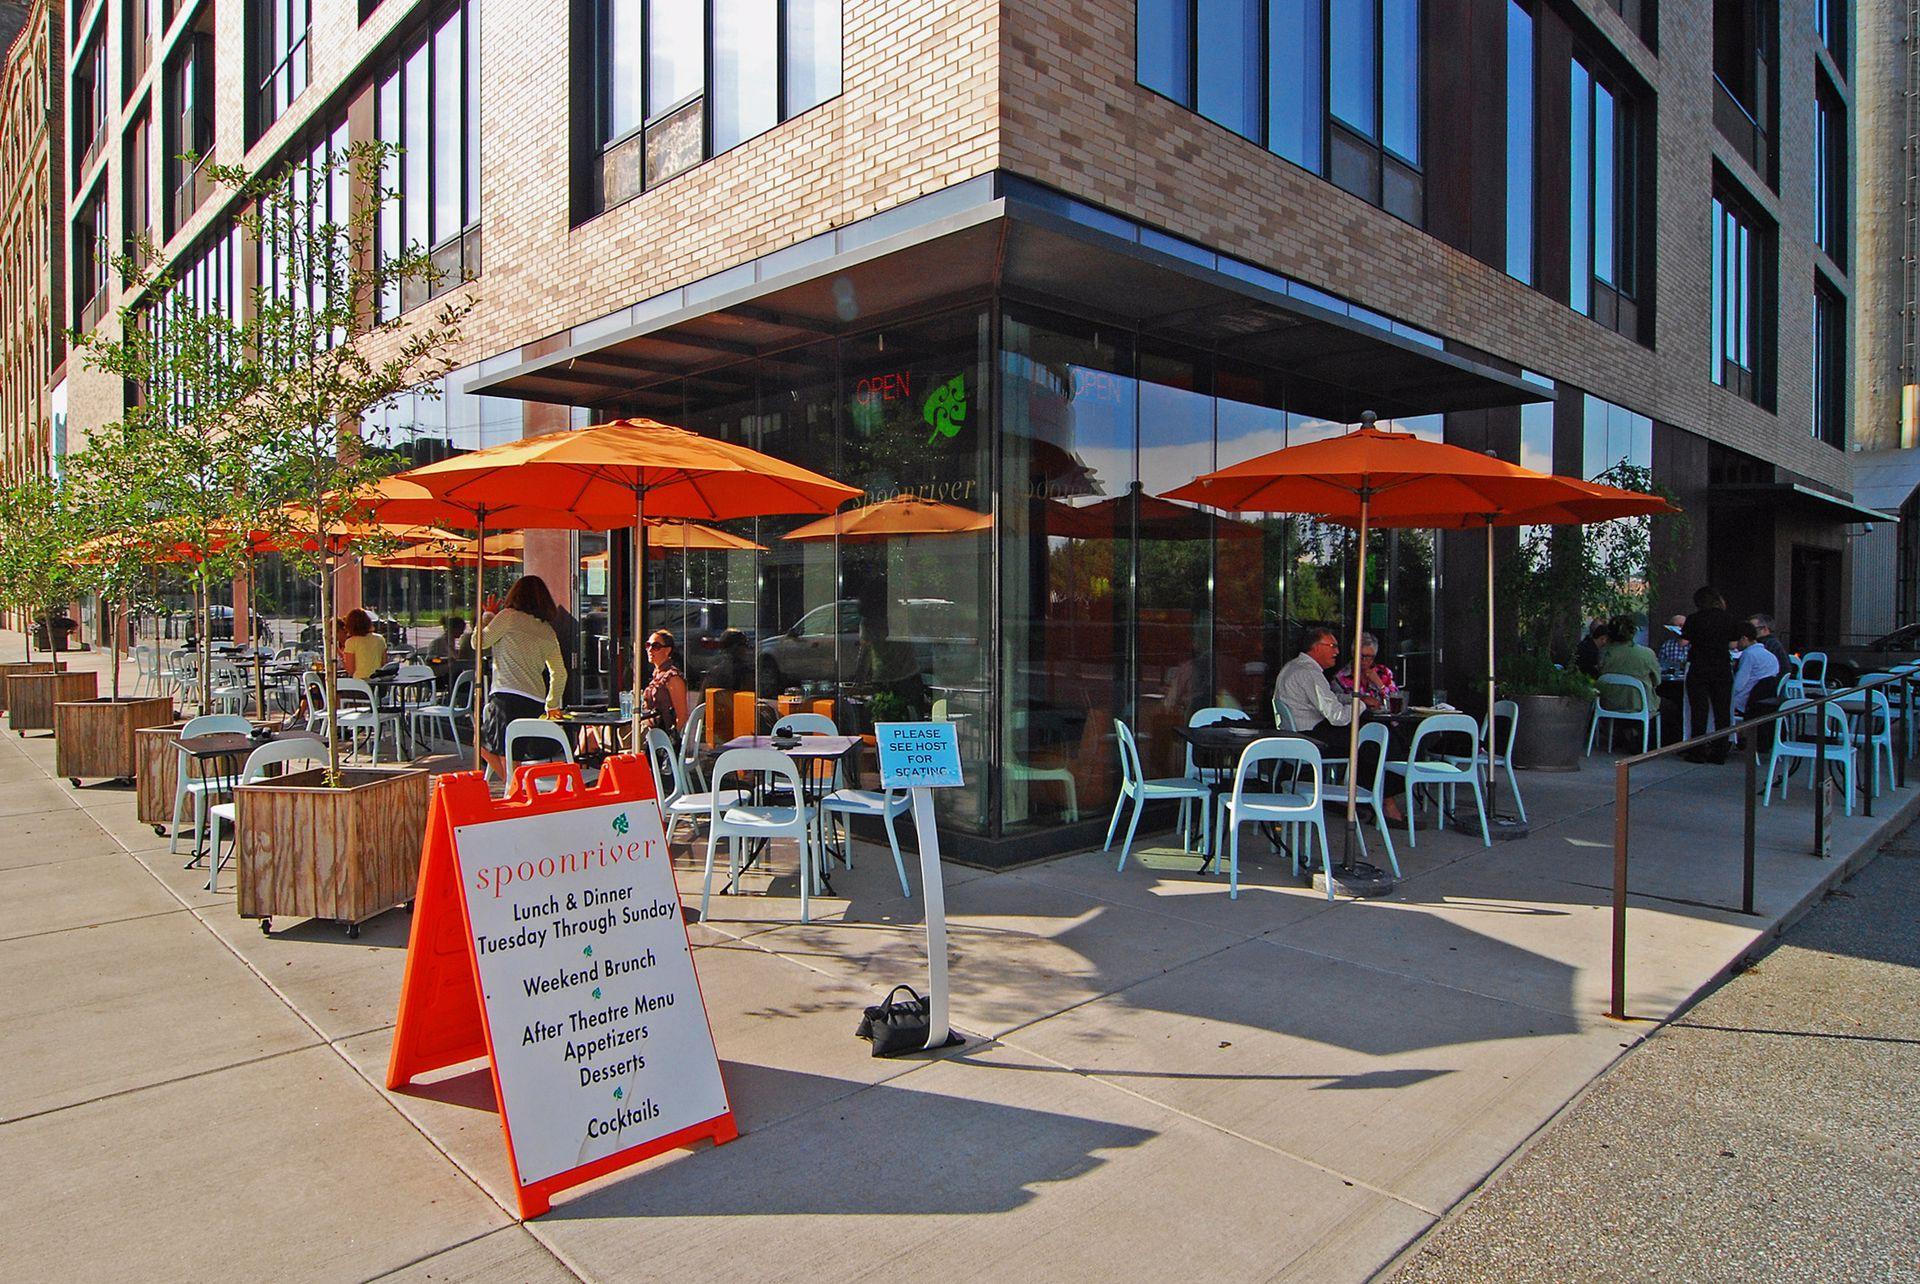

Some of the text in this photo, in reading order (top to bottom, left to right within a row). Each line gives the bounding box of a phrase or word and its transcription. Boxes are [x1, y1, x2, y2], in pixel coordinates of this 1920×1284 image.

[857, 371, 911, 405] OPEN
[1069, 368, 1121, 404] OPEN
[852, 475, 976, 518] spoonriver
[890, 742, 947, 751] SEE HOST
[894, 729, 941, 738] PLEASE
[908, 755, 932, 763] FOR
[476, 839, 656, 898] spoonriver
[514, 887, 633, 921] Lunch & Dinner
[478, 900, 676, 955] Tuesday Through Sunday
[523, 949, 656, 997] Weekend Brunch
[522, 994, 674, 1046] After Theatre Menu
[564, 1026, 649, 1063] Appetizers
[580, 1055, 645, 1087] Desserts
[588, 1098, 660, 1138] Cocktails
